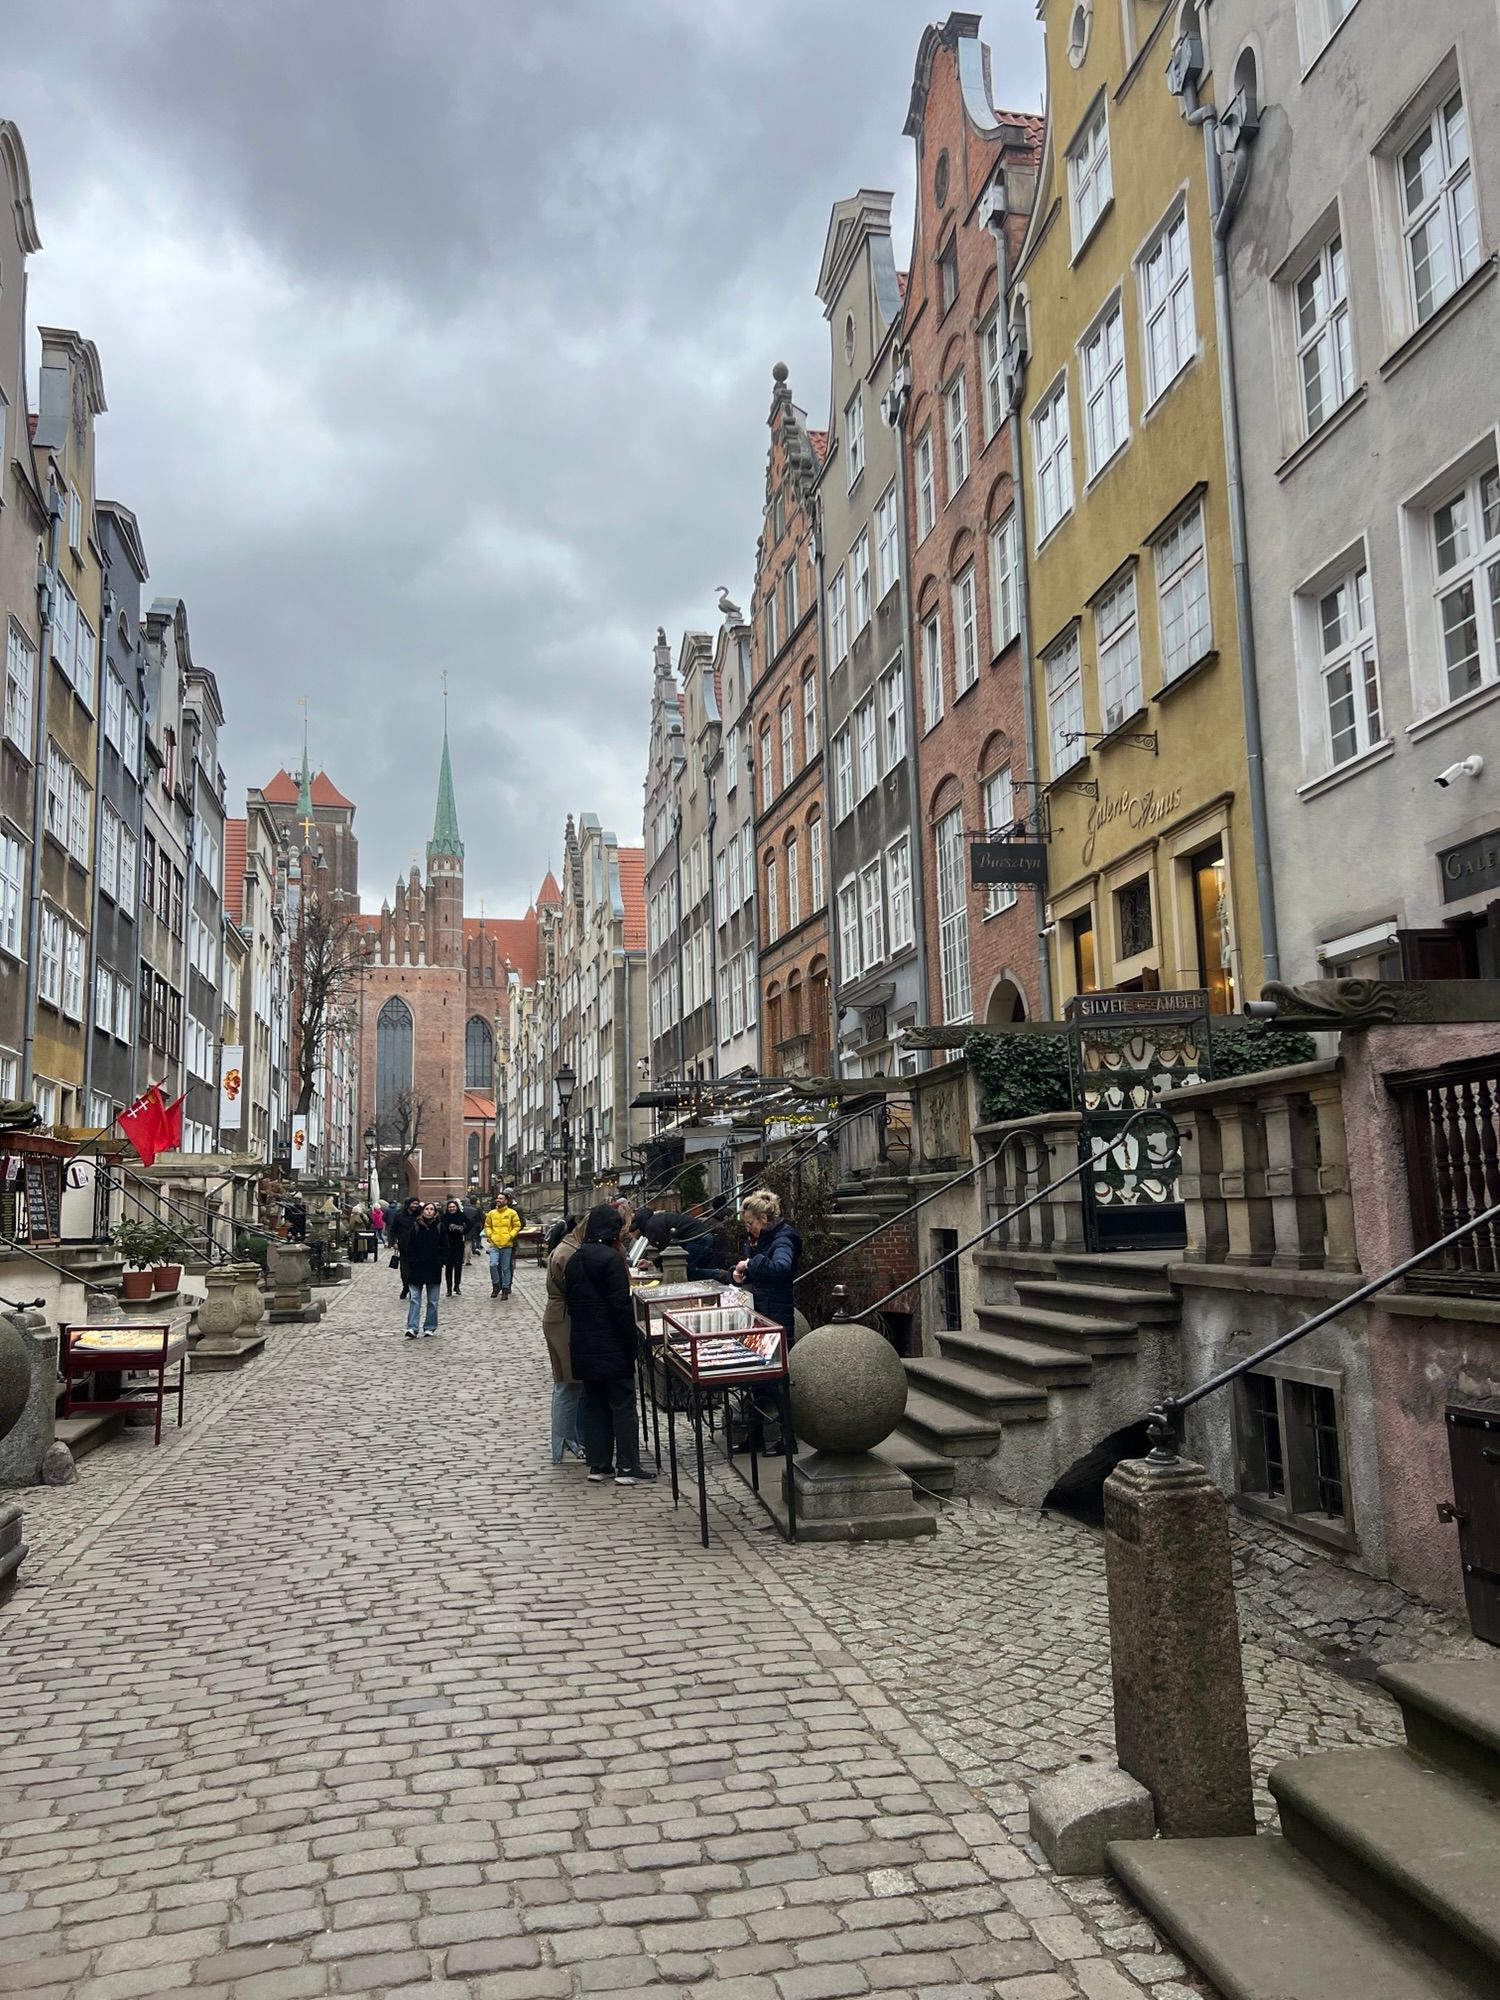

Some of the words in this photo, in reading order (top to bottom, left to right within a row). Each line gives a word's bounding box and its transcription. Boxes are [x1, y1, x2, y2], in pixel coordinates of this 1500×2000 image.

[1083, 787, 1130, 867] Galerie
[1128, 783, 1182, 830] Venus
[975, 851, 1041, 873] Bursztyn
[1446, 847, 1500, 880] GALE
[1081, 999, 1127, 1015] SILVER
[1156, 994, 1205, 1011] AMBER
